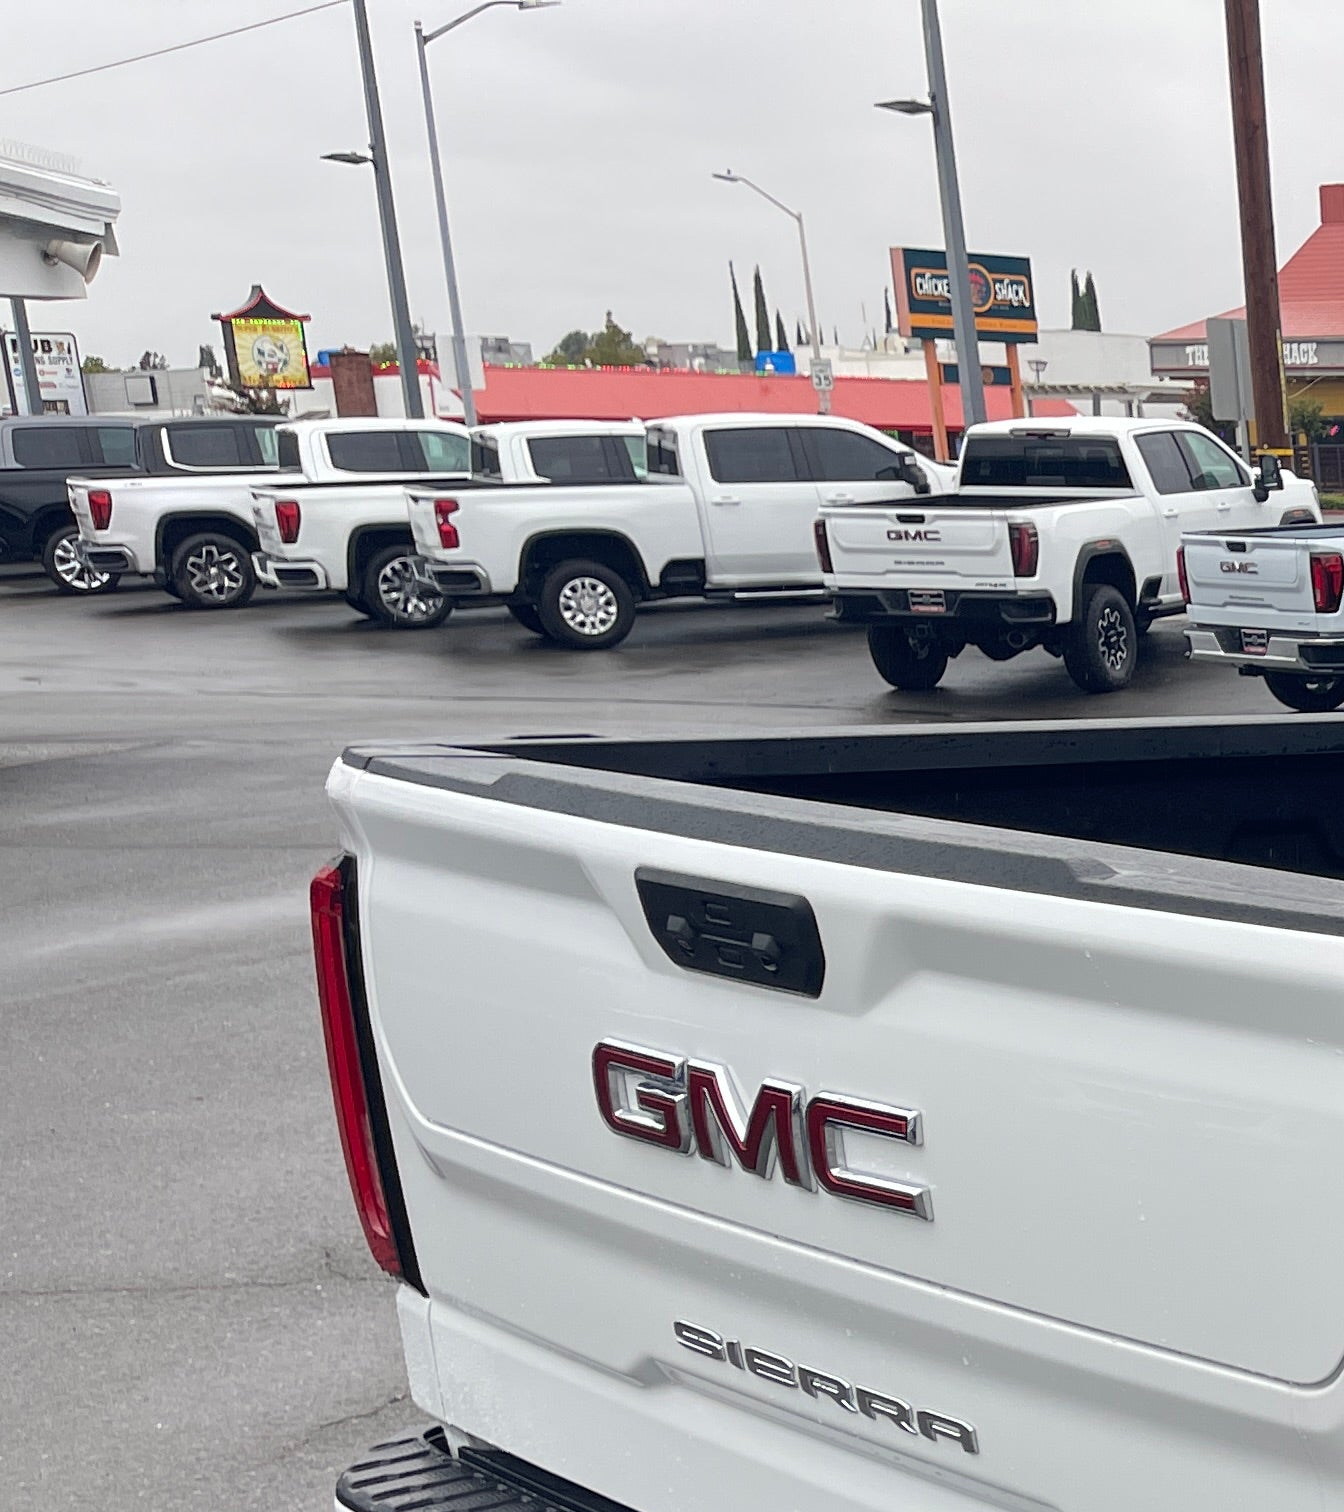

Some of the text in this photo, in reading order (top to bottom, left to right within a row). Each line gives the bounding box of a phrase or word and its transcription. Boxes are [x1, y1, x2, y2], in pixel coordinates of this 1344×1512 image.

[915, 272, 1030, 308] CHICKE SHACK
[1282, 342, 1318, 365] HACK
[886, 529, 942, 542] GMC
[1219, 561, 1259, 575] GMC
[592, 1036, 935, 1222] GMC
[673, 1319, 980, 1455] SIERRA
